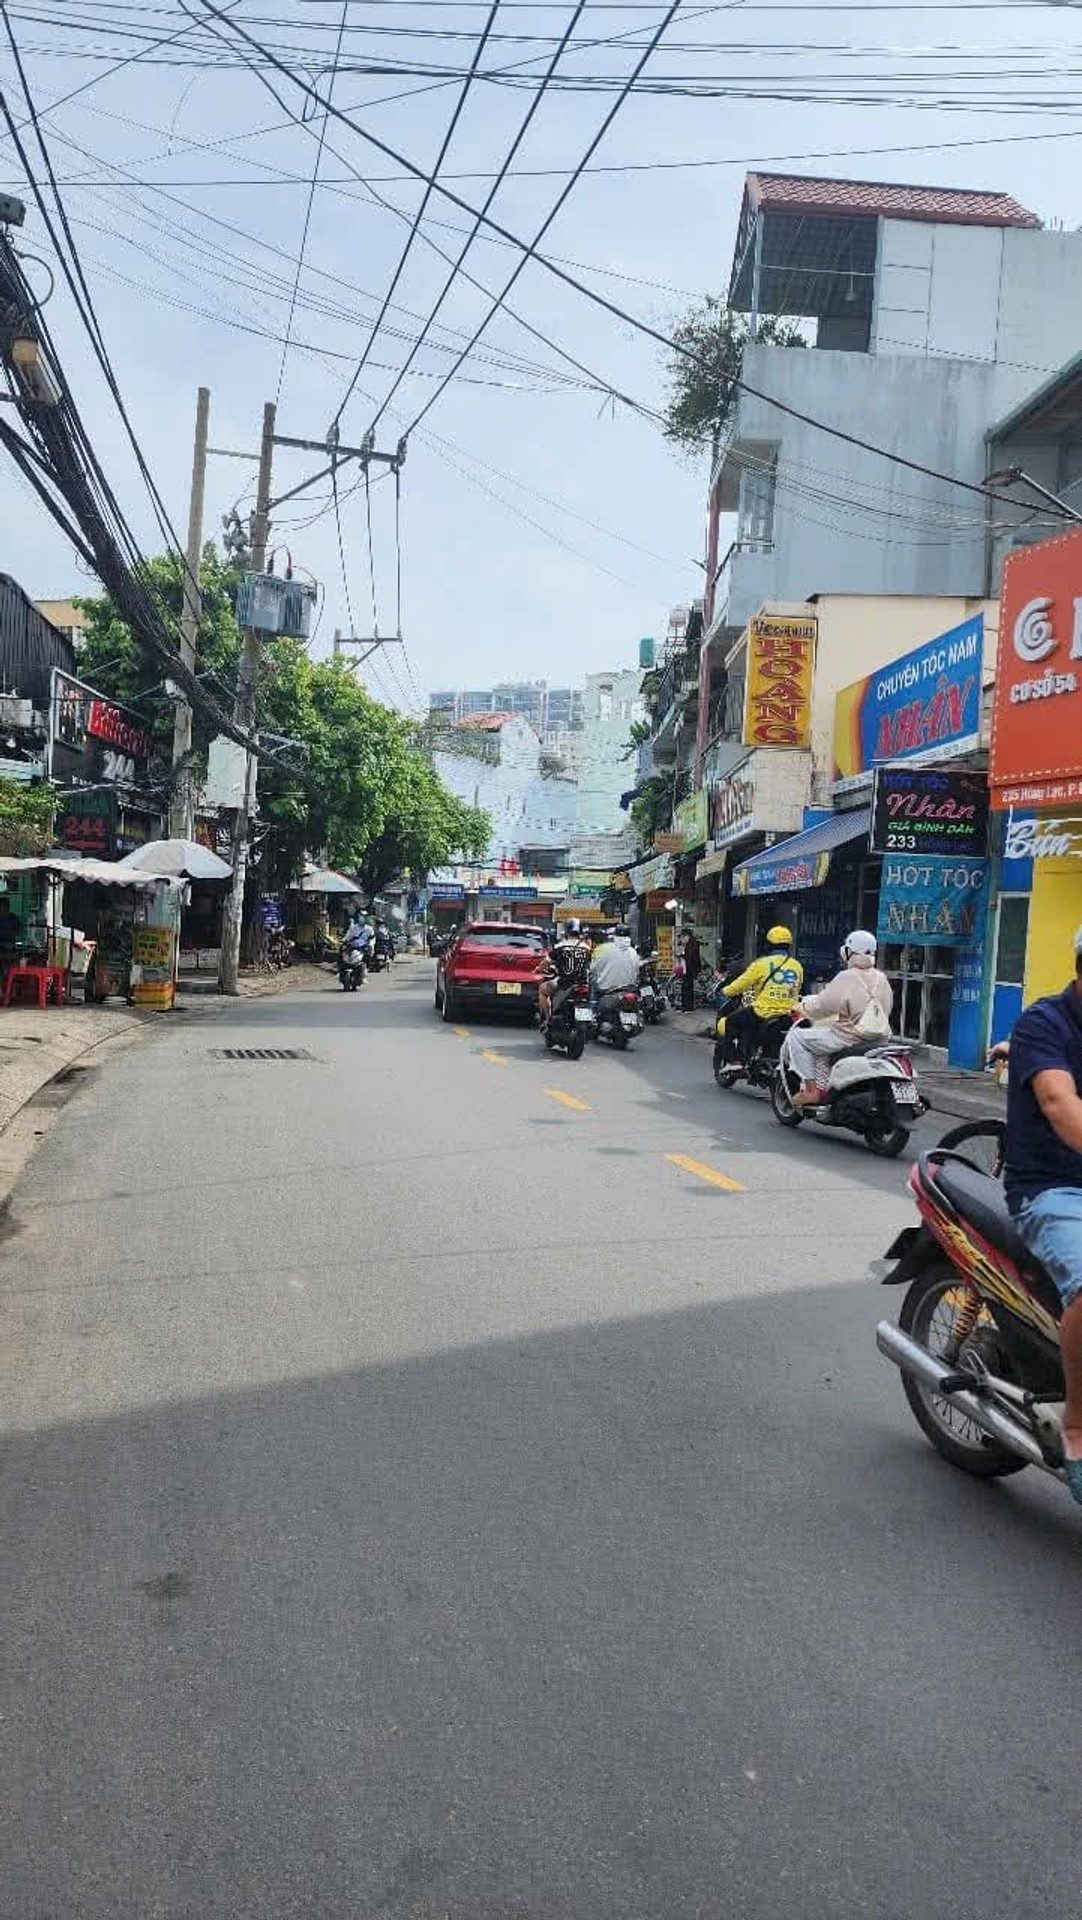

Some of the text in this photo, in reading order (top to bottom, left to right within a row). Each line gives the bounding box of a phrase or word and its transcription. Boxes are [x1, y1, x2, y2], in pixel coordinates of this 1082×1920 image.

[877, 632, 977, 702] CHUYÊN TÓC NAM
[874, 673, 976, 758] NHÂN
[887, 792, 976, 819] Nhân
[886, 834, 917, 849] 233
[886, 862, 984, 889] HỚT TÓC
[888, 897, 975, 935] NHÂN
